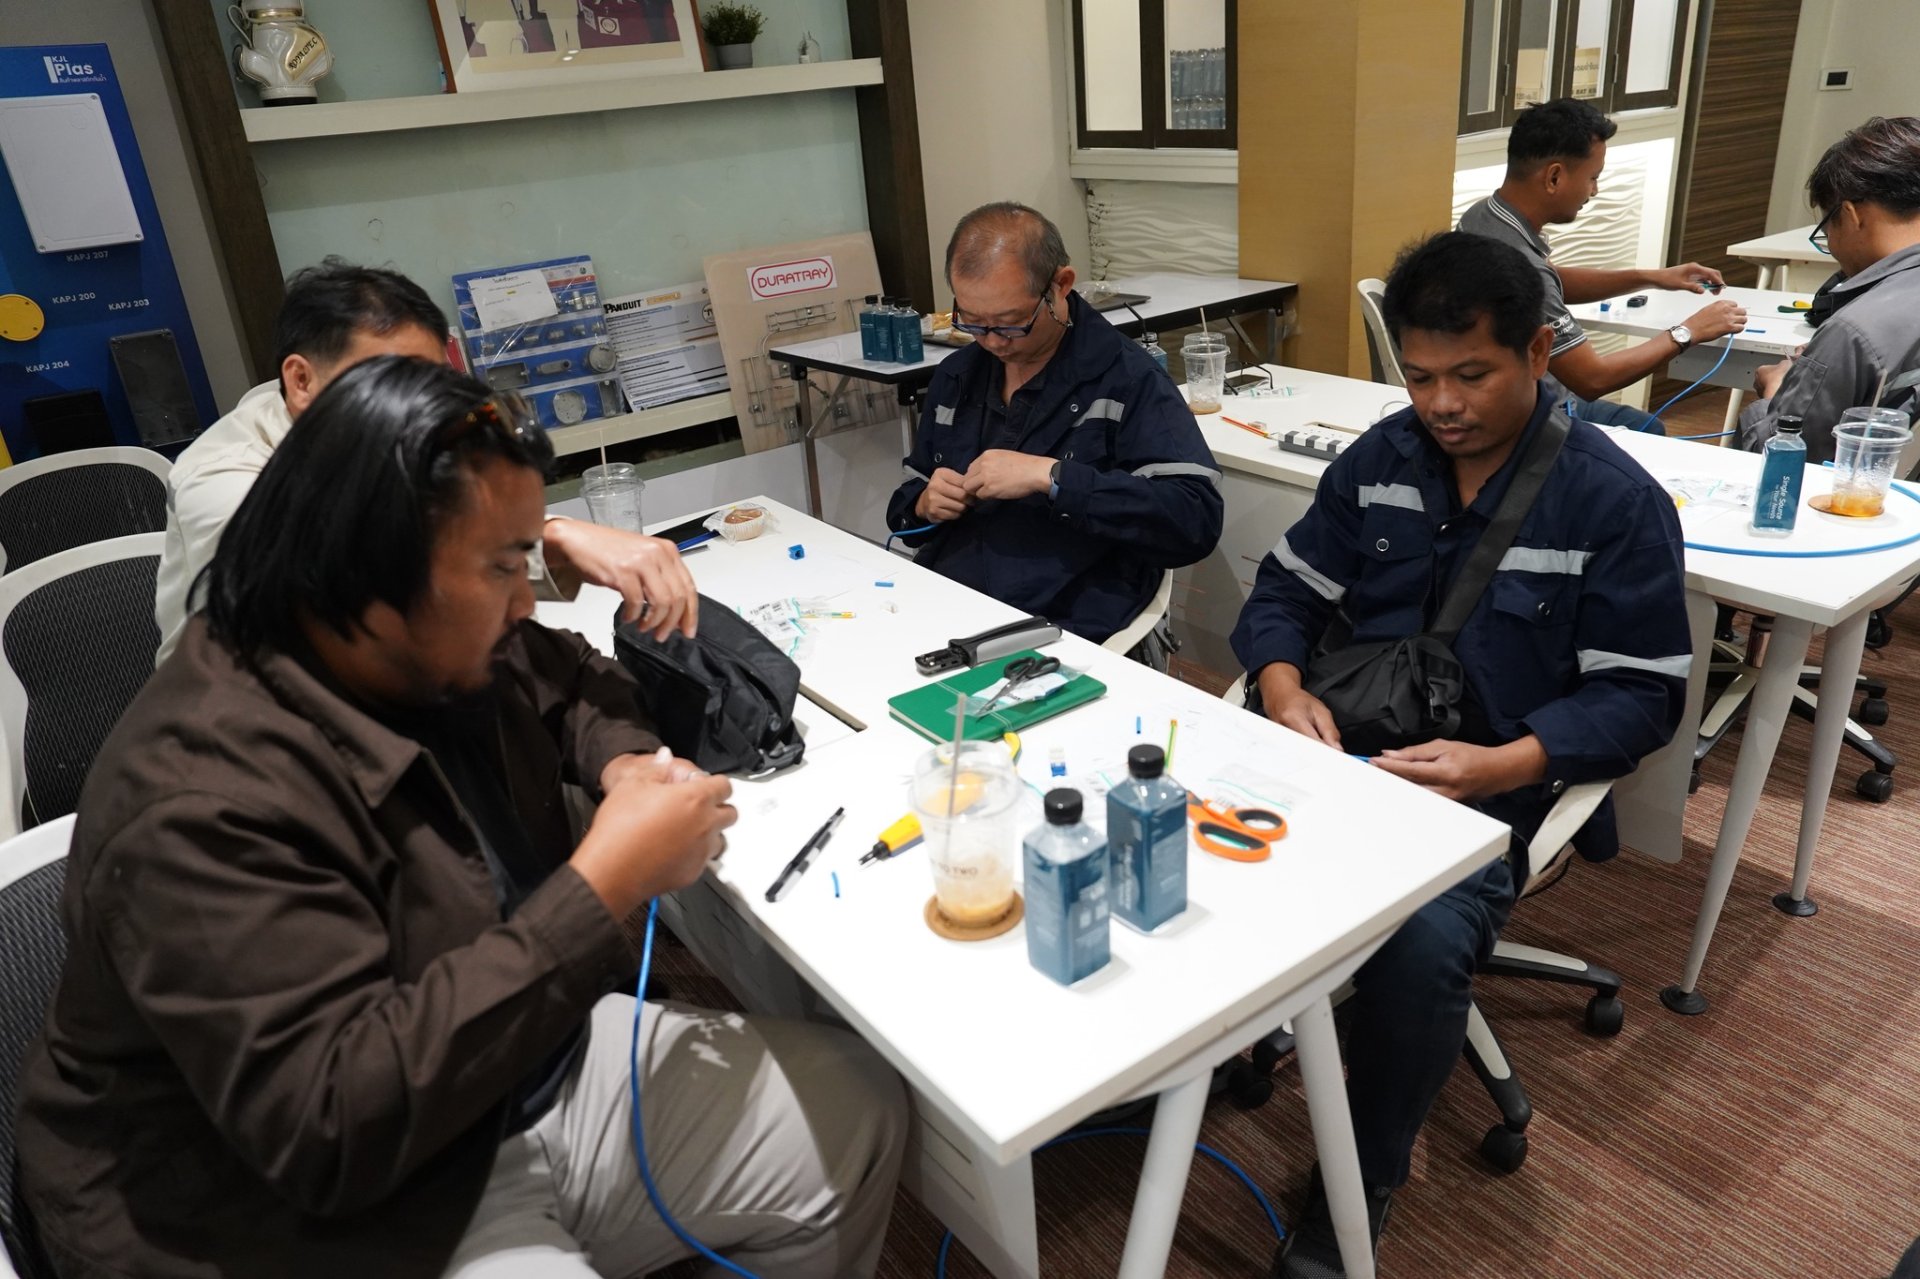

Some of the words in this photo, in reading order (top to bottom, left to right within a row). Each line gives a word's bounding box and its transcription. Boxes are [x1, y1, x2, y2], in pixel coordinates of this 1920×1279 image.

[51, 55, 69, 63] KJL
[54, 63, 94, 76] Plas
[66, 252, 91, 262] KAPJ
[93, 250, 109, 259] 207
[757, 266, 829, 289] DURATRAY
[52, 294, 77, 304] KAPJ
[78, 291, 96, 300] 200
[108, 301, 132, 311] KAPJ
[133, 298, 150, 307] 203
[603, 299, 642, 314] PANDUIT
[25, 363, 51, 373] KAPJ
[52, 360, 70, 369] 204
[1780, 475, 1790, 497] Single
[1776, 498, 1786, 520] Source
